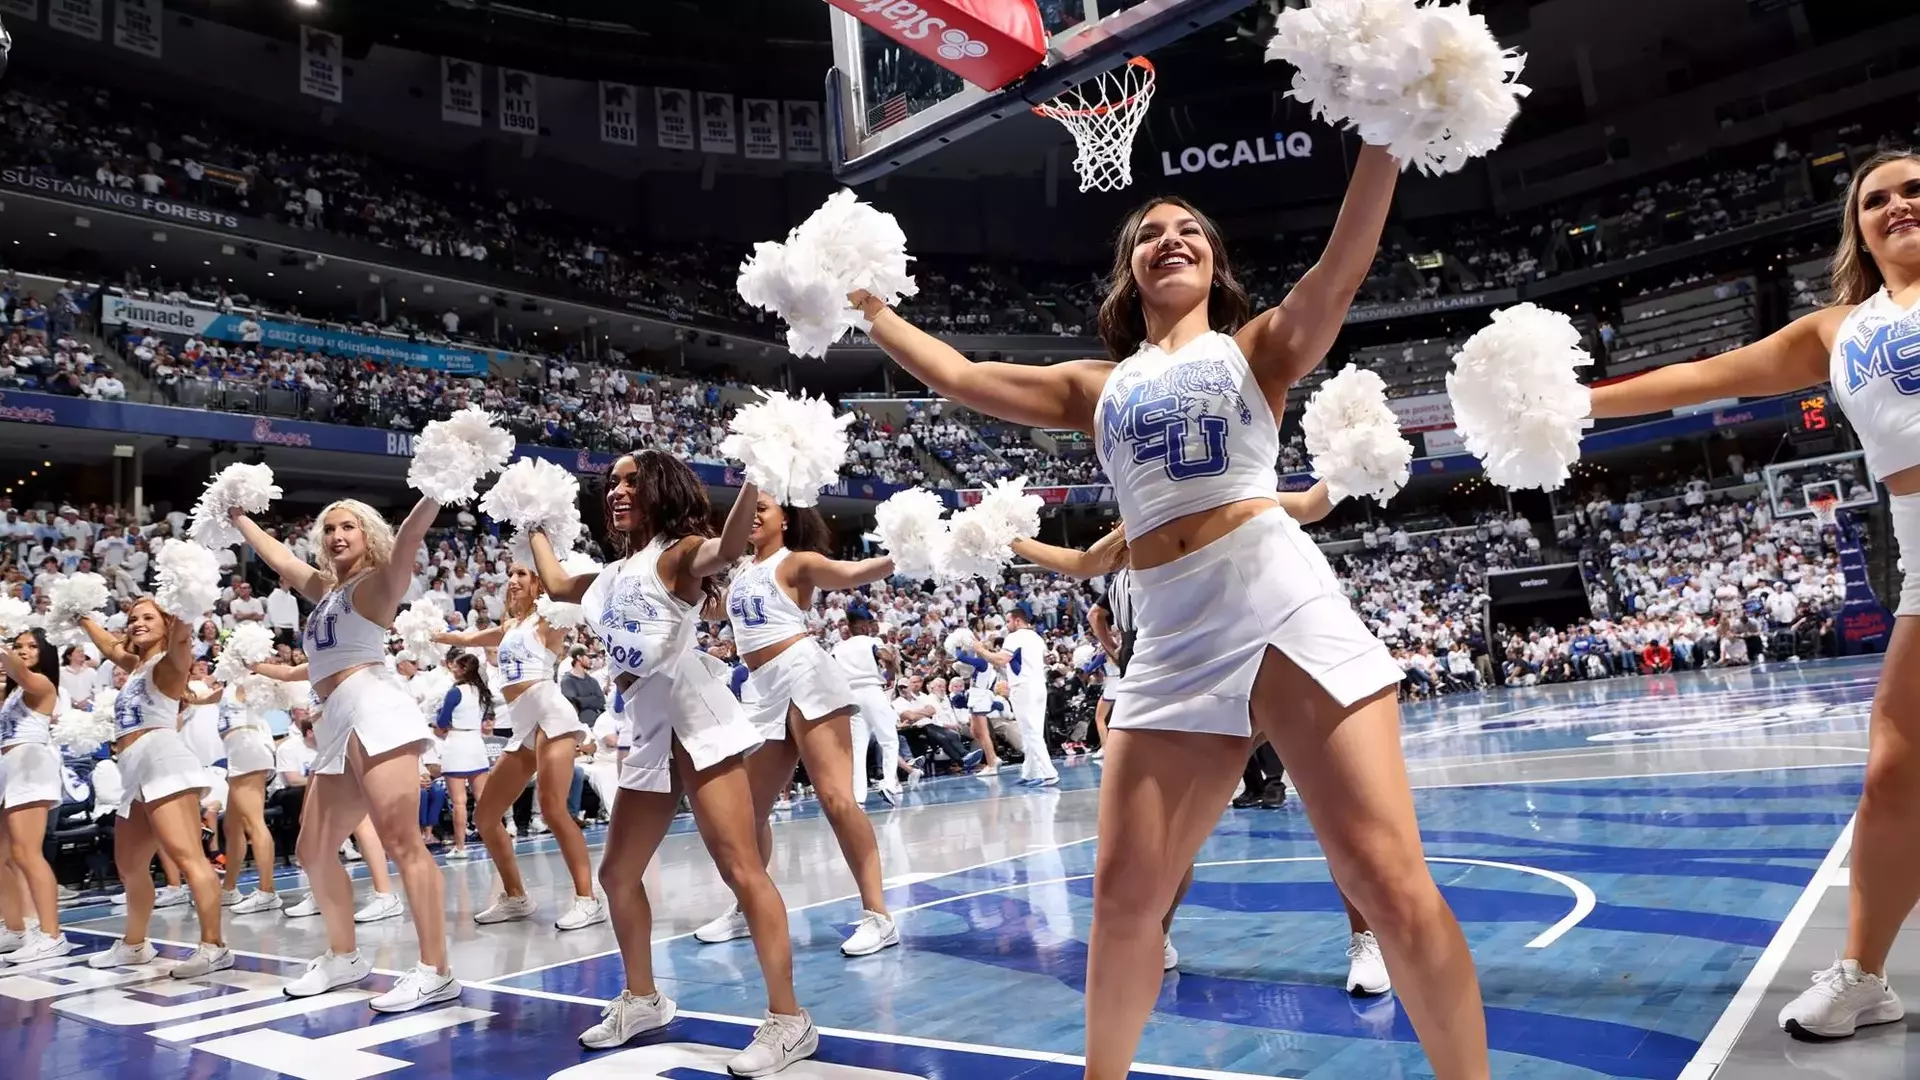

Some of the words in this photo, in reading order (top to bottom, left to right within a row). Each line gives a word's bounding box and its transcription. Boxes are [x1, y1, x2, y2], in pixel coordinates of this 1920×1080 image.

[856, 0, 947, 39] Stat
[504, 113, 535, 130] 1990
[604, 124, 634, 141] 1991
[1161, 131, 1313, 176] LOCALiQ
[2, 170, 136, 208] SUSTAINING
[142, 198, 239, 228] FORESTS
[114, 300, 195, 329] Pinnacle
[1348, 306, 1402, 321] PROVING
[1404, 303, 1431, 313] OUR
[1433, 294, 1486, 309] PLANET
[267, 329, 297, 343] GRIZZ
[299, 334, 324, 347] CARD
[337, 340, 429, 362] GrizzliesBanking.com
[1102, 380, 1230, 482] MSU
[1803, 409, 1828, 430] 15
[1519, 578, 1549, 588] verizon
